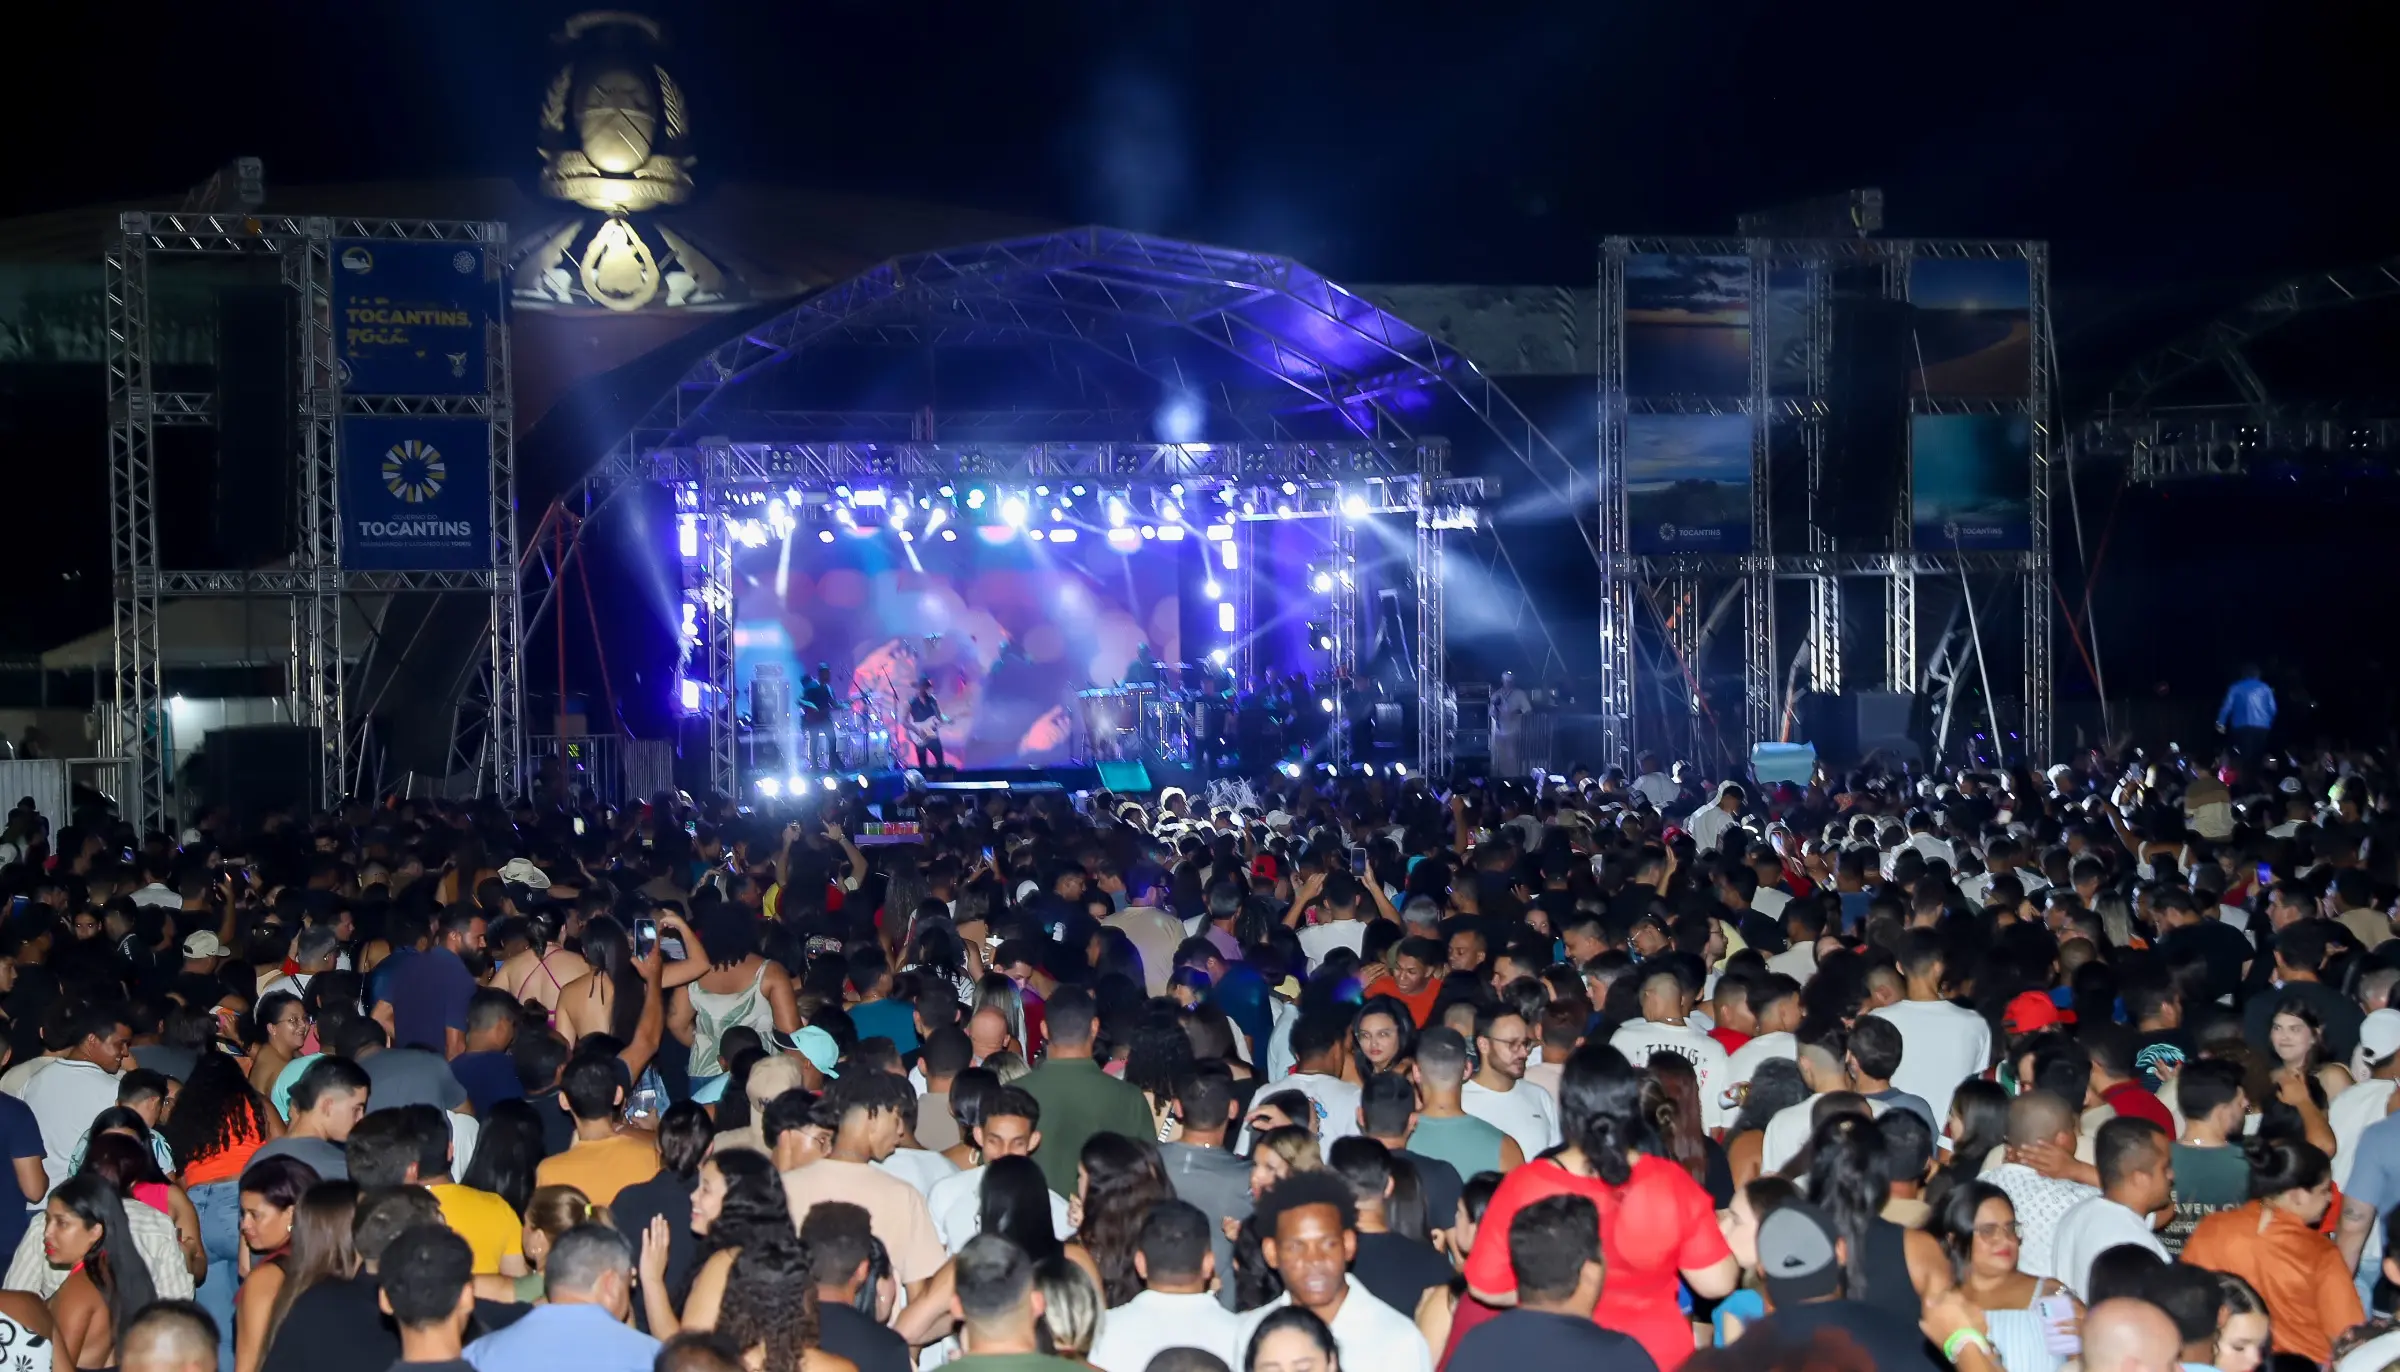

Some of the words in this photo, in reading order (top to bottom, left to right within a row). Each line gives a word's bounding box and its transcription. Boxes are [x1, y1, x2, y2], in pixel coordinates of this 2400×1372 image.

[358, 521, 472, 537] TOCANTINS
[1678, 528, 1721, 537] TOCANTINS
[1961, 527, 2003, 535] TOCANTINS
